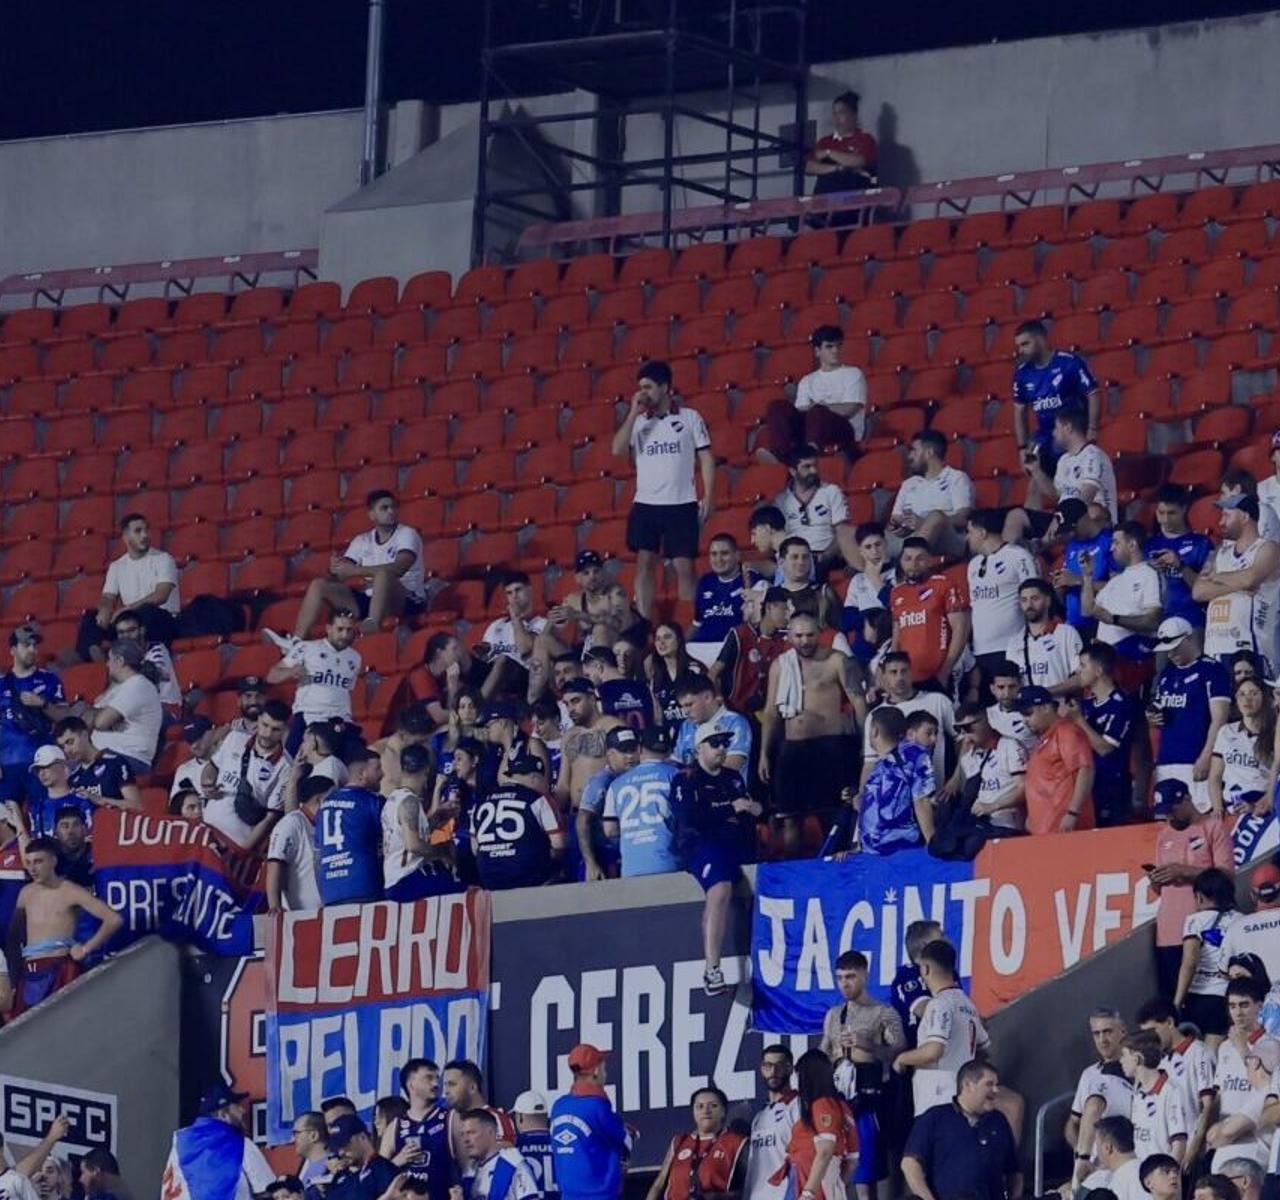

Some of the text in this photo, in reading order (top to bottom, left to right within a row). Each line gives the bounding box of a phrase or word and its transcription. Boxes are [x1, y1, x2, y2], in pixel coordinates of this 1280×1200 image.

[646, 440, 681, 456] antel
[476, 799, 527, 842] 25
[617, 781, 673, 829] 25
[323, 809, 346, 850] 4
[275, 893, 472, 1003] CERRO
[10, 1092, 106, 1143] SPFC
